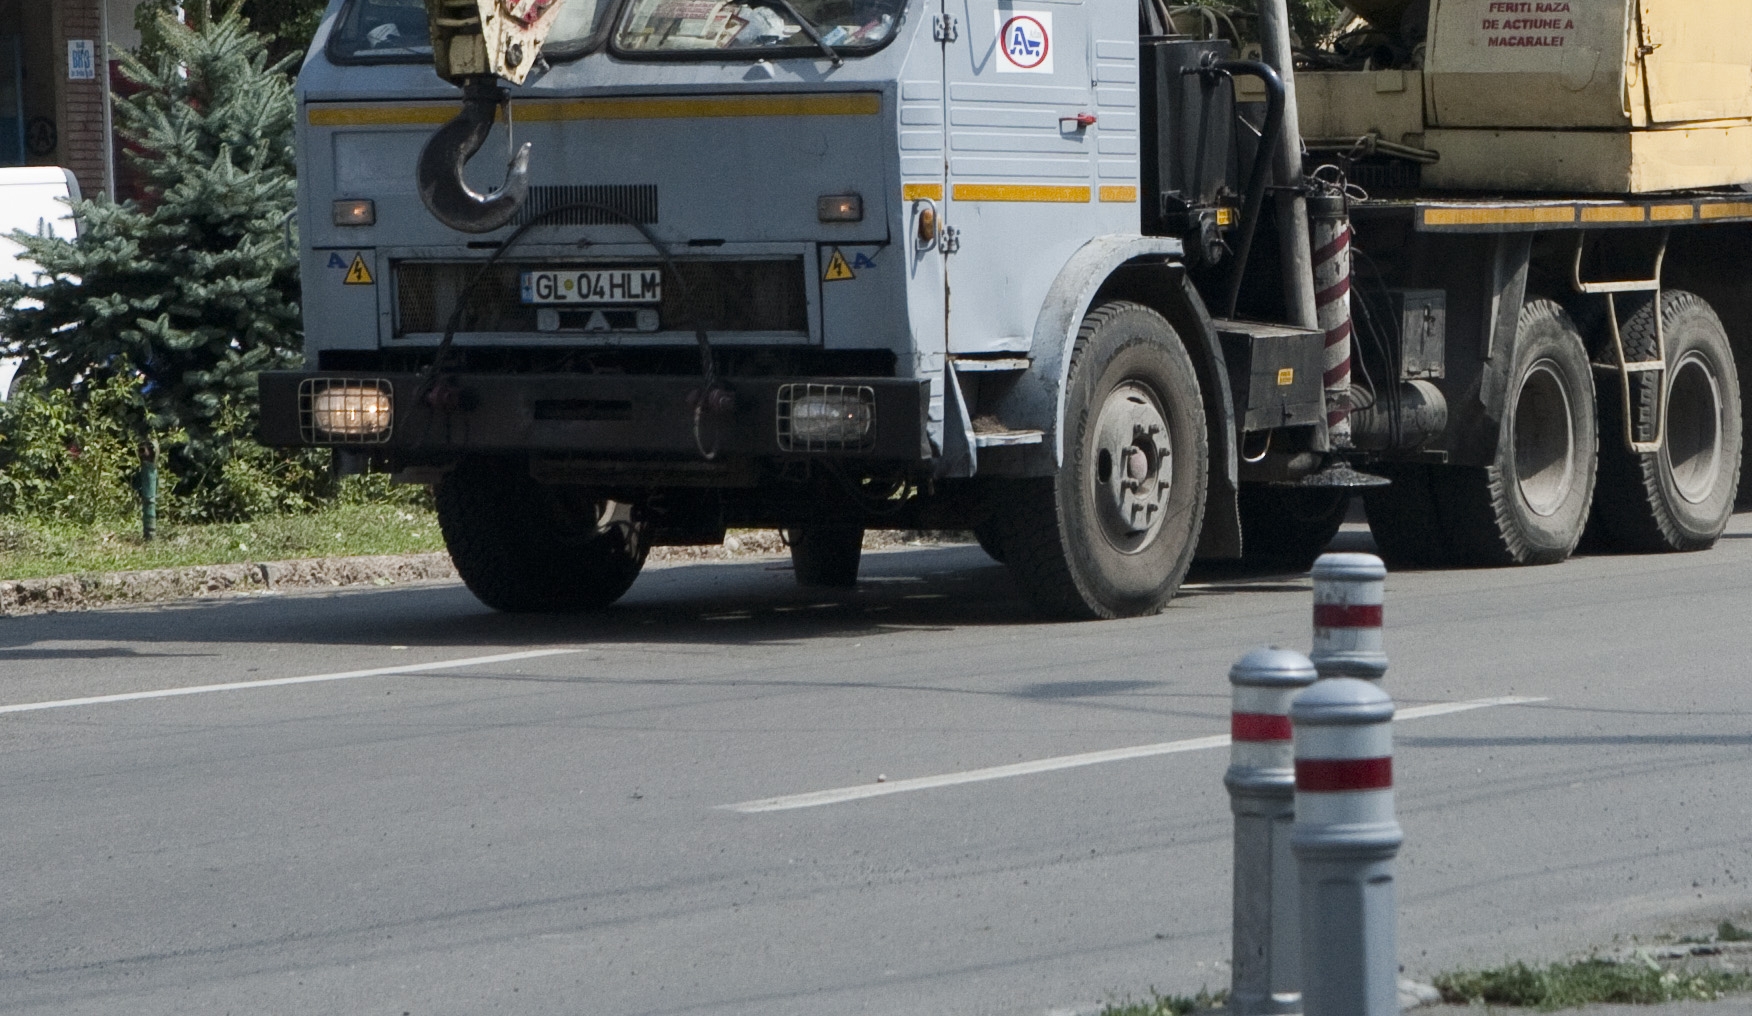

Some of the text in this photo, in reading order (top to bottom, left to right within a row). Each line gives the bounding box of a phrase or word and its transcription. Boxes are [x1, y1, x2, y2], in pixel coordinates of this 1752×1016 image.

[1489, 2, 1570, 13] FERITI RAZA
[1482, 18, 1574, 30] DE ACTIUNE A
[1488, 36, 1565, 47] MACARALEI
[536, 272, 657, 300] GL 04 HLM
